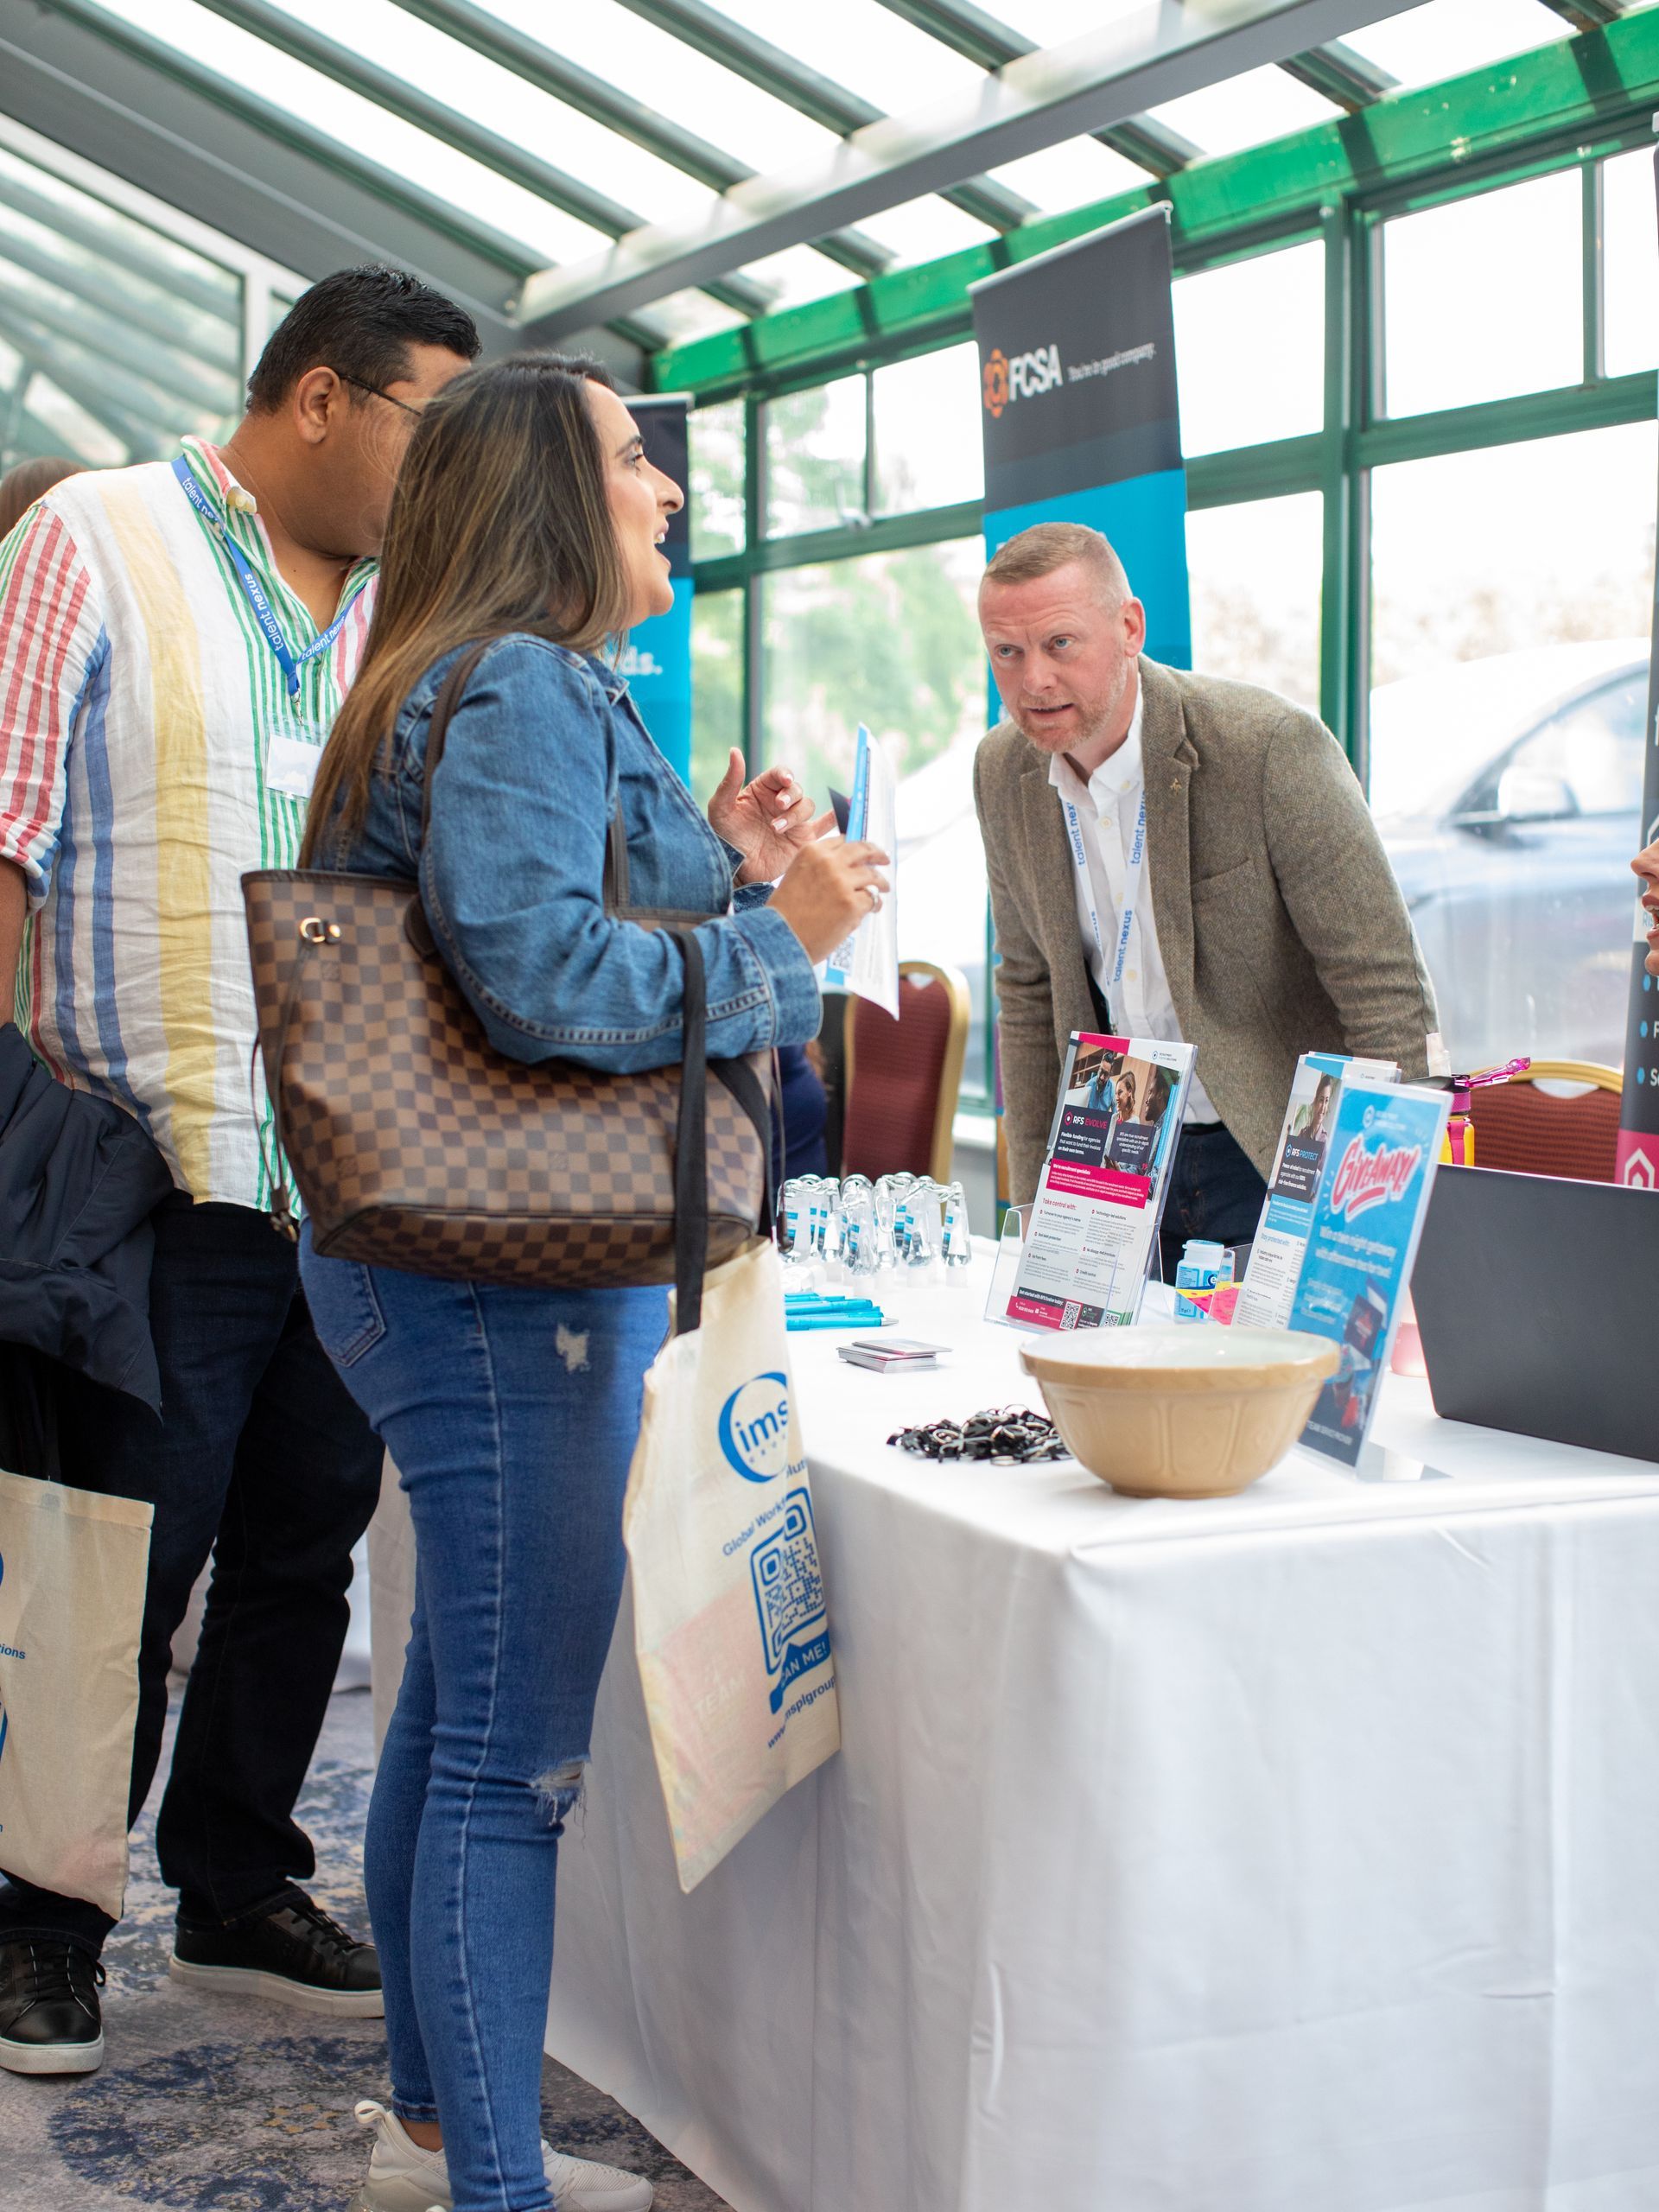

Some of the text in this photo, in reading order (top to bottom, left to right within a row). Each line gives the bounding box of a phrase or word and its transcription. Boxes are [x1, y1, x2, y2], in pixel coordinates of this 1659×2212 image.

[1008, 344, 1064, 402] FCSA
[182, 476, 204, 509] talent
[245, 573, 284, 652] talent nexus
[302, 632, 332, 661] talent
[1071, 828, 1086, 865] talent
[1130, 830, 1145, 864] talent
[1114, 910, 1133, 982] talent nexus
[1072, 1116, 1108, 1128] RFS EVOLVE
[1299, 1150, 1319, 1160] PROTECT
[722, 1522, 755, 1556] Global
[0, 1643, 26, 1660] ions
[802, 1641, 828, 1666] ME!
